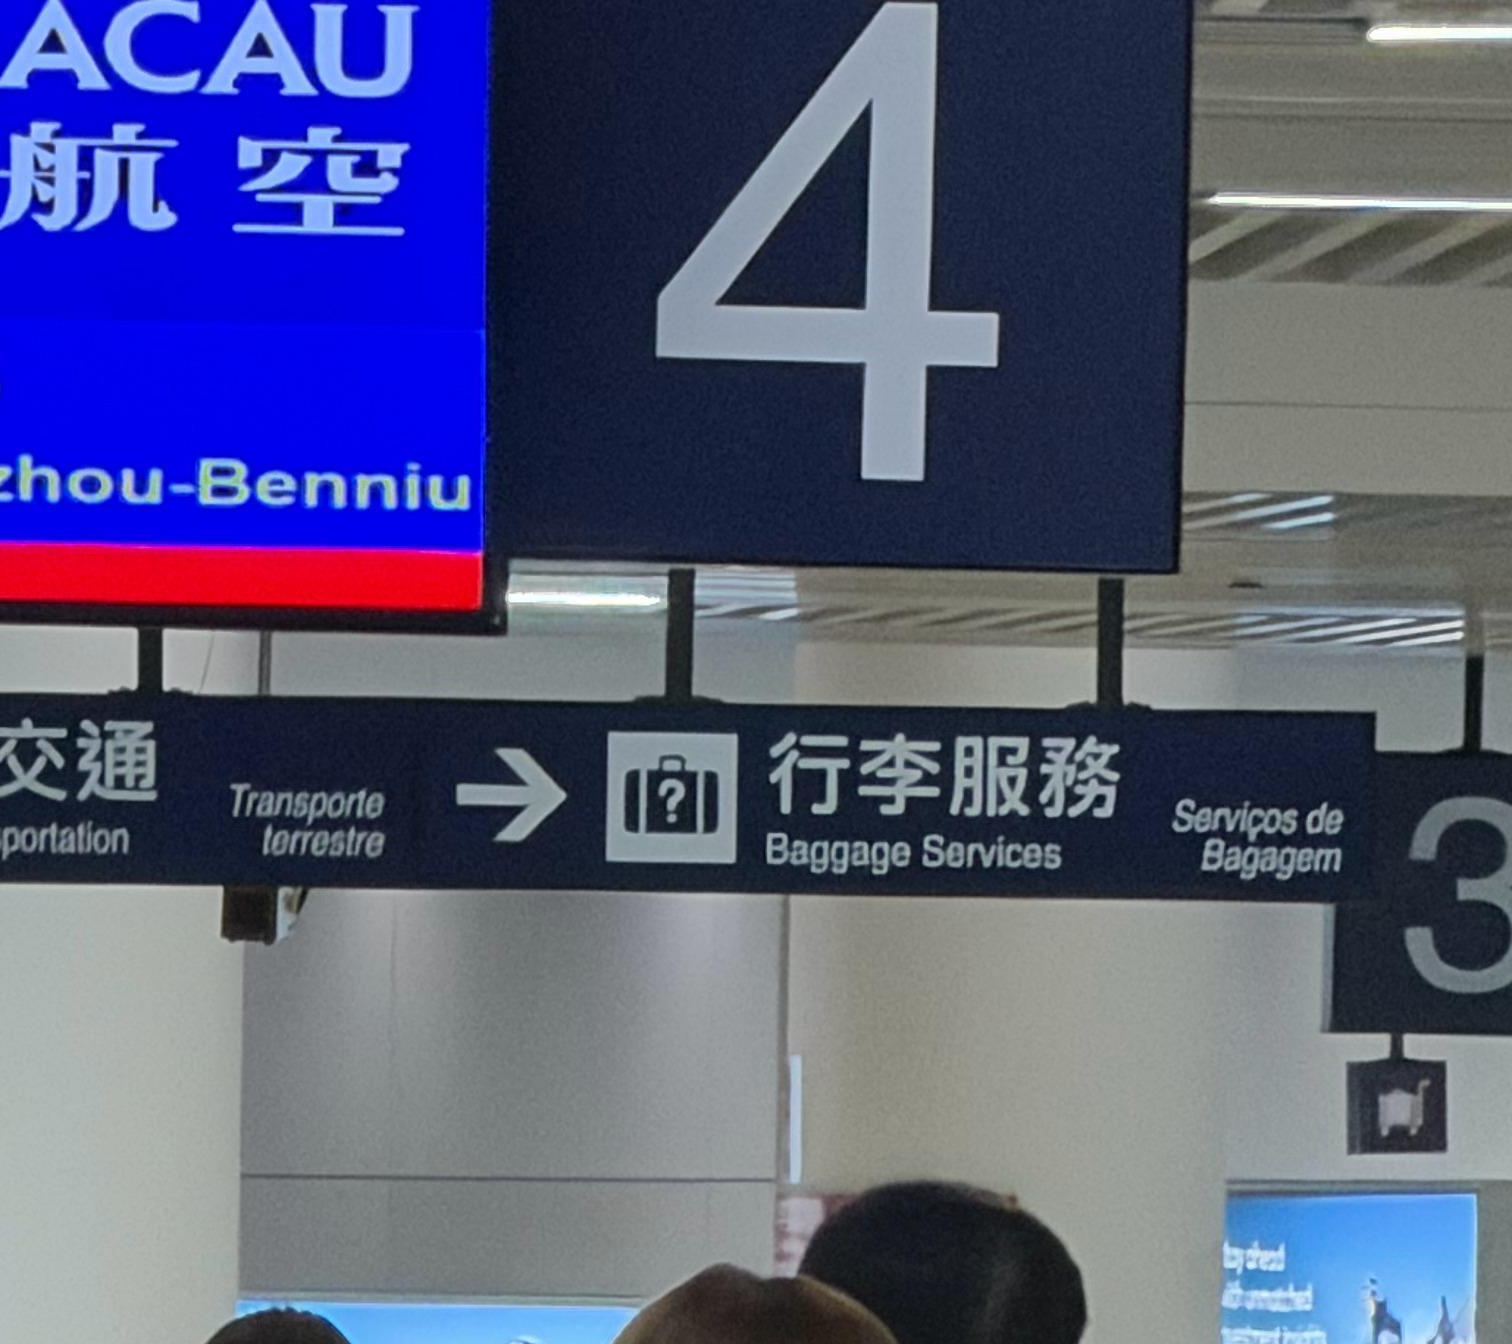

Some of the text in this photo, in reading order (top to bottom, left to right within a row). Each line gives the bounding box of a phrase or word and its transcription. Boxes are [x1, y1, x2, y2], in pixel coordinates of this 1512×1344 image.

[656, 0, 999, 481] 4
[767, 731, 1122, 820] 行李服務
[229, 783, 385, 825] Transporte
[1172, 798, 1344, 838] Serviços de
[262, 825, 386, 859] terrestre
[765, 832, 1063, 875] Baggage Services
[1200, 838, 1342, 880] Bagagem
[1404, 797, 1512, 994] 3
